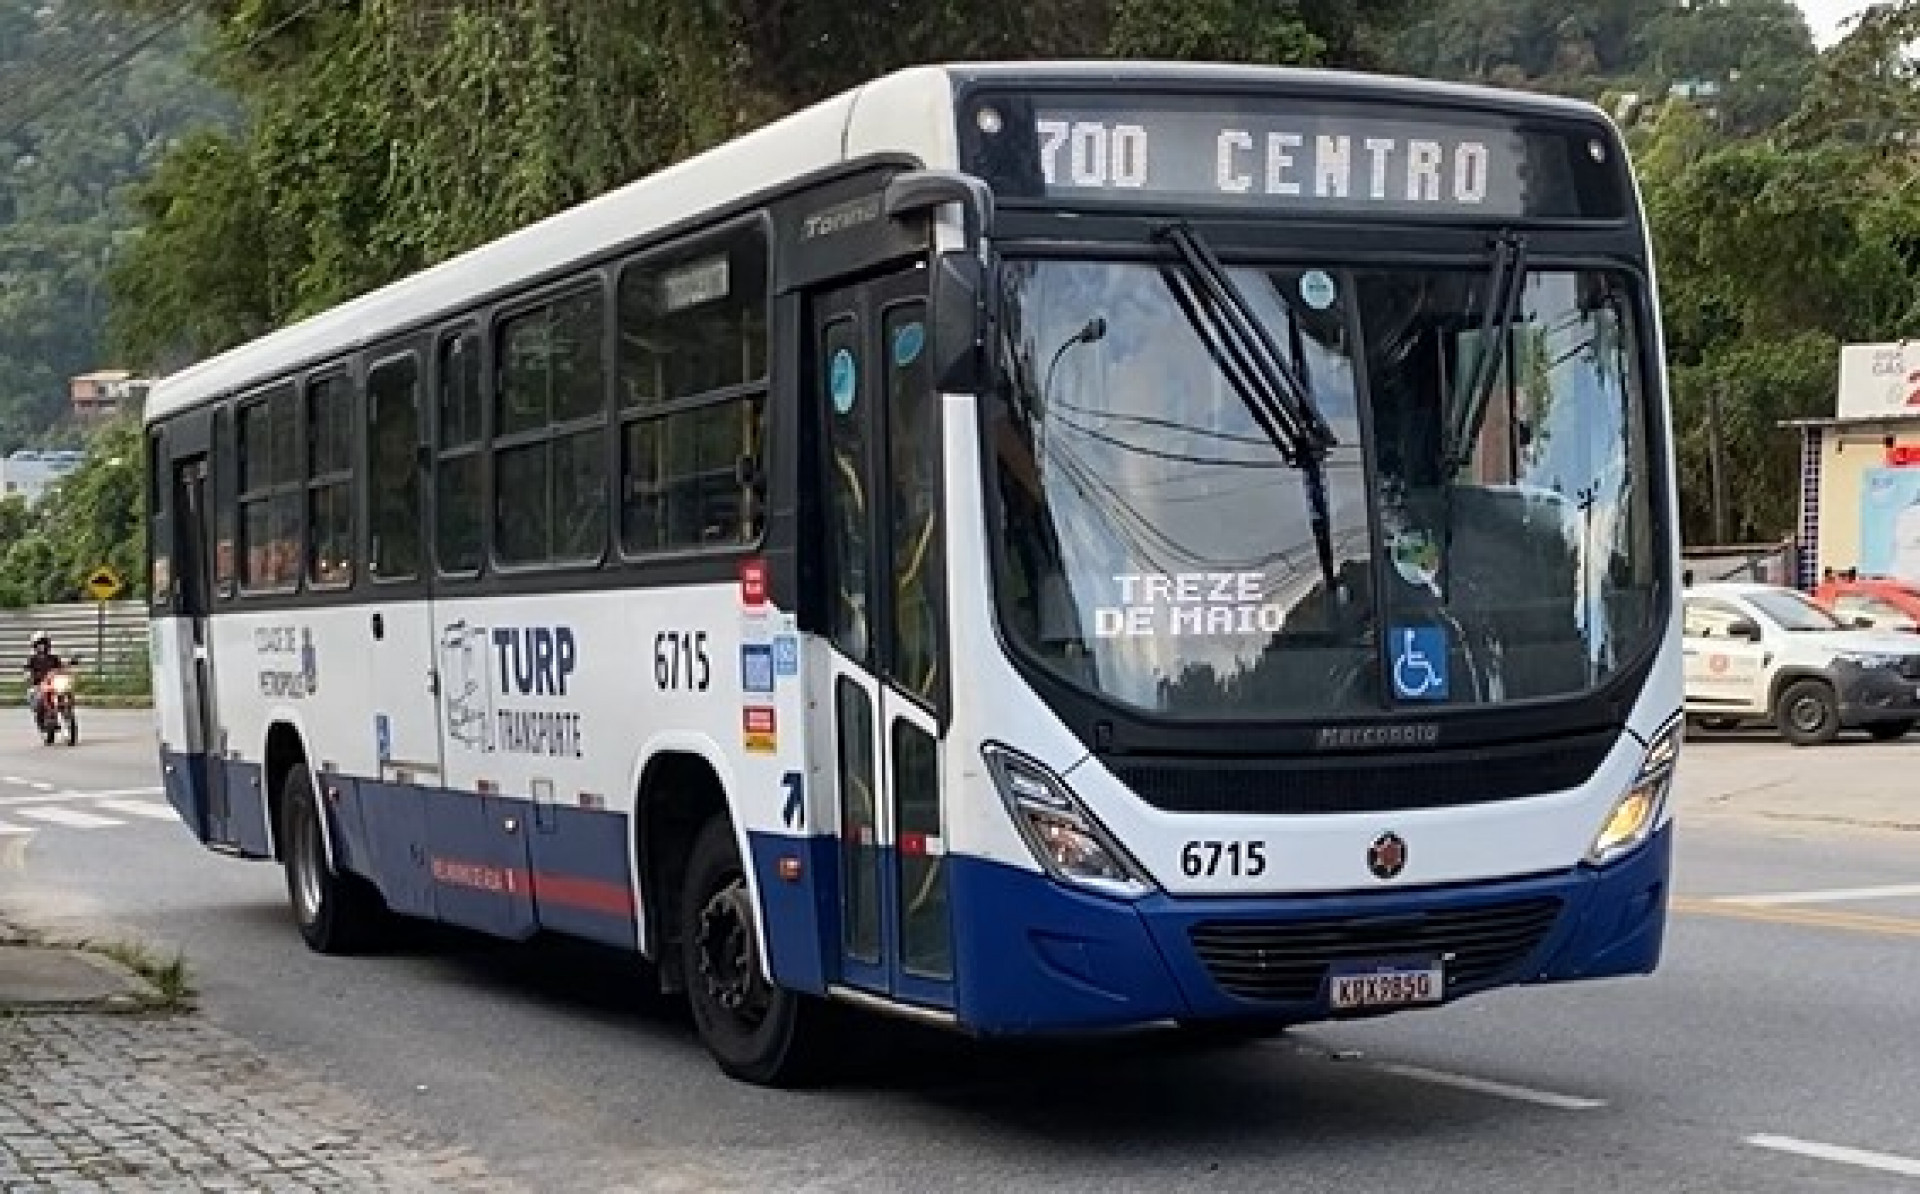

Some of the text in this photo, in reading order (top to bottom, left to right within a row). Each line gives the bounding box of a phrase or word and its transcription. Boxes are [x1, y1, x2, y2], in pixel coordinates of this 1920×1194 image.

[1036, 120, 1490, 204] 700 CENTRO
[1112, 573, 1266, 602] TREZE
[1094, 603, 1286, 638] DE MAIO
[491, 626, 576, 696] TURP
[653, 630, 710, 692] 6715
[497, 708, 584, 761] TRANSPORTE
[1182, 840, 1267, 879] 6715
